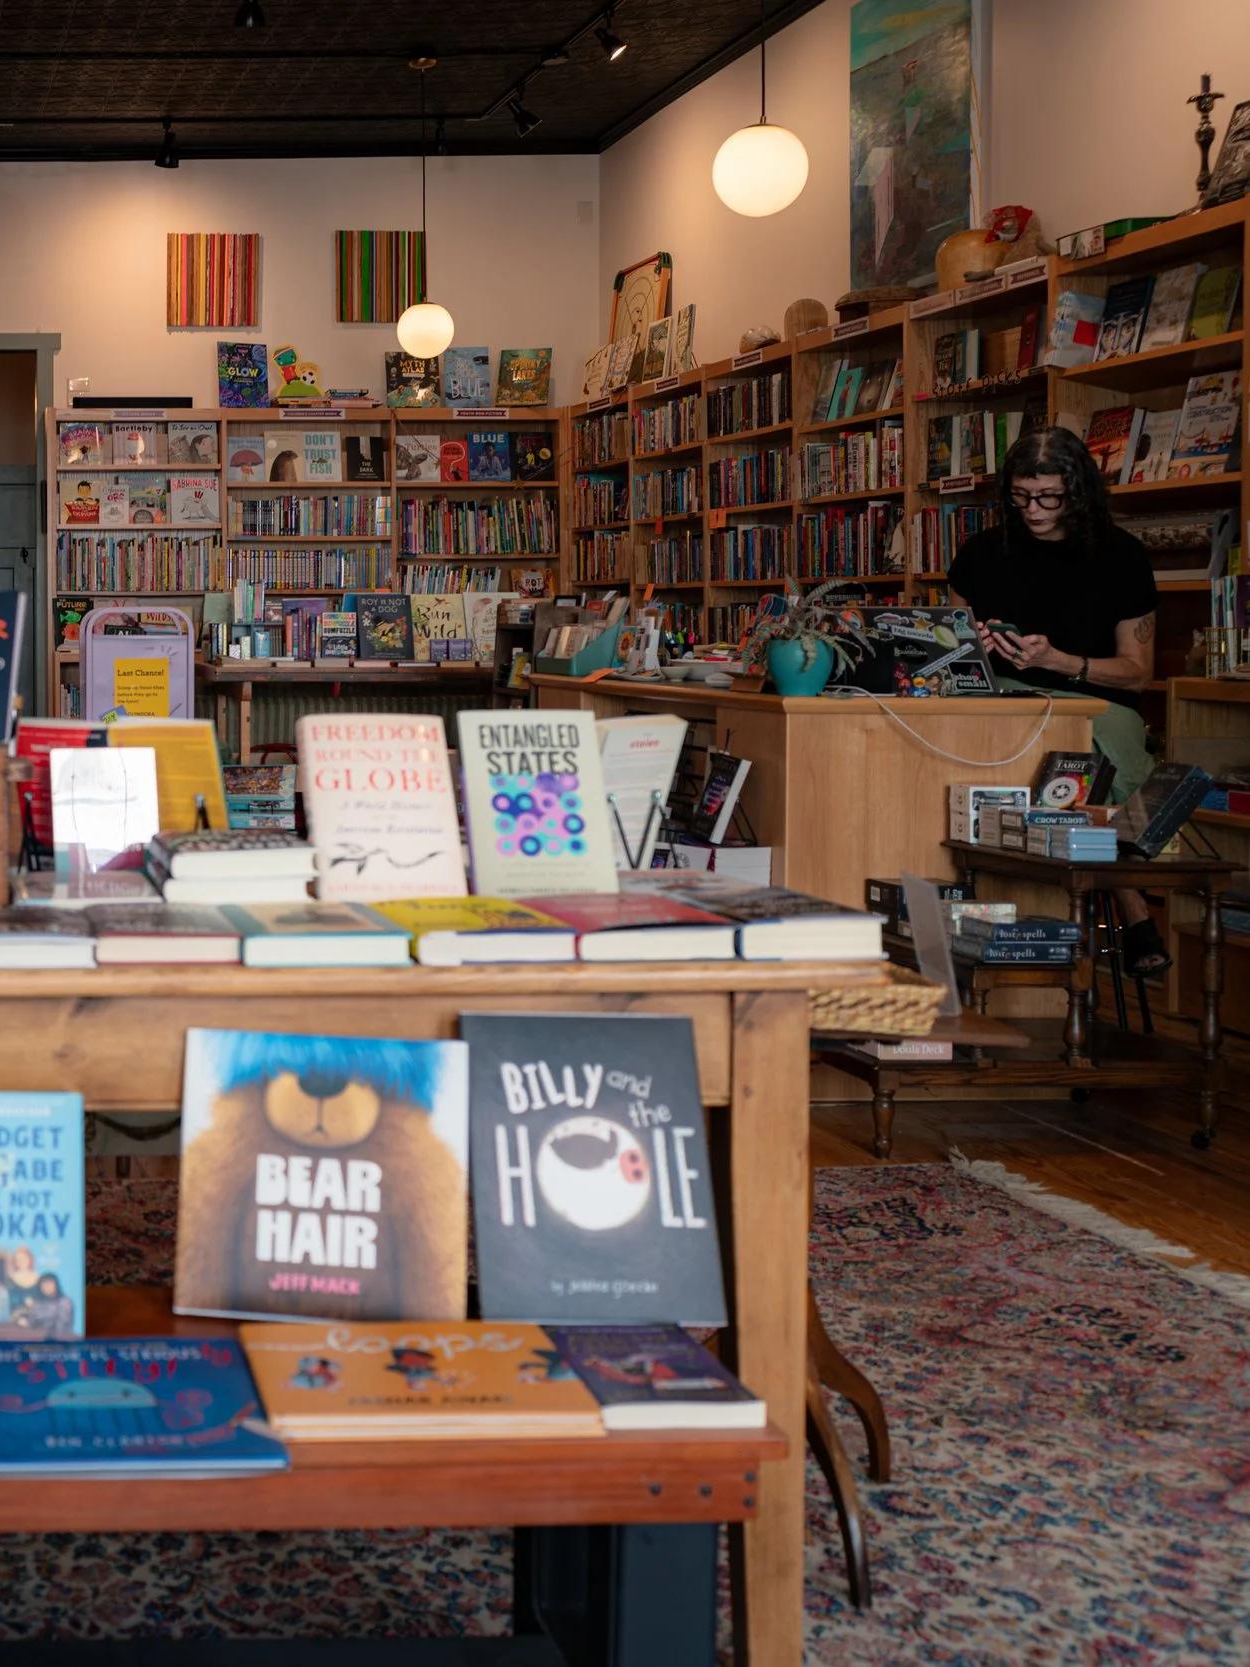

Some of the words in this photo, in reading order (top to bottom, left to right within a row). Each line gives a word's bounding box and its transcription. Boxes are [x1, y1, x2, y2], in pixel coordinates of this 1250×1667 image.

[400, 359, 426, 368] MYTH
[401, 366, 426, 374] ATLAS
[228, 365, 259, 379] GLOW
[512, 368, 536, 382] LAKES
[450, 376, 485, 399] BLUE
[115, 424, 153, 433] Bartleby
[305, 434, 335, 446] DON'T
[472, 433, 506, 444] BLUE
[304, 448, 337, 460] TRUST
[309, 463, 333, 475] FISH
[172, 478, 203, 492] SABRINA
[204, 478, 218, 492] SUE
[525, 578, 544, 590] ROT
[56, 601, 88, 609] FUTURE
[361, 598, 378, 607] ROY
[378, 605, 399, 614] DOG
[419, 604, 451, 620] Run
[323, 627, 356, 636] BUMFUZZLE
[414, 621, 458, 640] Wild
[117, 669, 133, 677] Last
[135, 669, 165, 677] Chance!
[953, 673, 980, 685] shop
[958, 679, 988, 689] small
[311, 723, 440, 744] FREEDOM
[479, 723, 581, 750] ENTANGLED
[315, 746, 393, 764] ROUND
[400, 745, 440, 764] THE
[486, 750, 579, 777] STATES
[1056, 761, 1087, 771] TAROT
[314, 768, 448, 794] GLOBE
[1035, 815, 1059, 825] CROW
[1059, 815, 1085, 825] TAROT
[1000, 929, 1016, 939] lost
[1022, 929, 1047, 942] spells
[989, 948, 1005, 959] lost
[1012, 949, 1037, 961] spells
[893, 1043, 920, 1055] Doula
[922, 1043, 945, 1055] Deck
[500, 1061, 603, 1116] BILLY
[605, 1068, 652, 1099] and
[626, 1100, 672, 1130] the
[255, 1153, 383, 1213] BEAR
[8, 1189, 54, 1209] NOT
[255, 1209, 379, 1270] HAIR
[268, 1273, 308, 1295] JEFF
[309, 1274, 361, 1296] MACK
[28, 1347, 82, 1362] BOOK
[91, 1348, 111, 1363] IS
[44, 1434, 83, 1448] BEN
